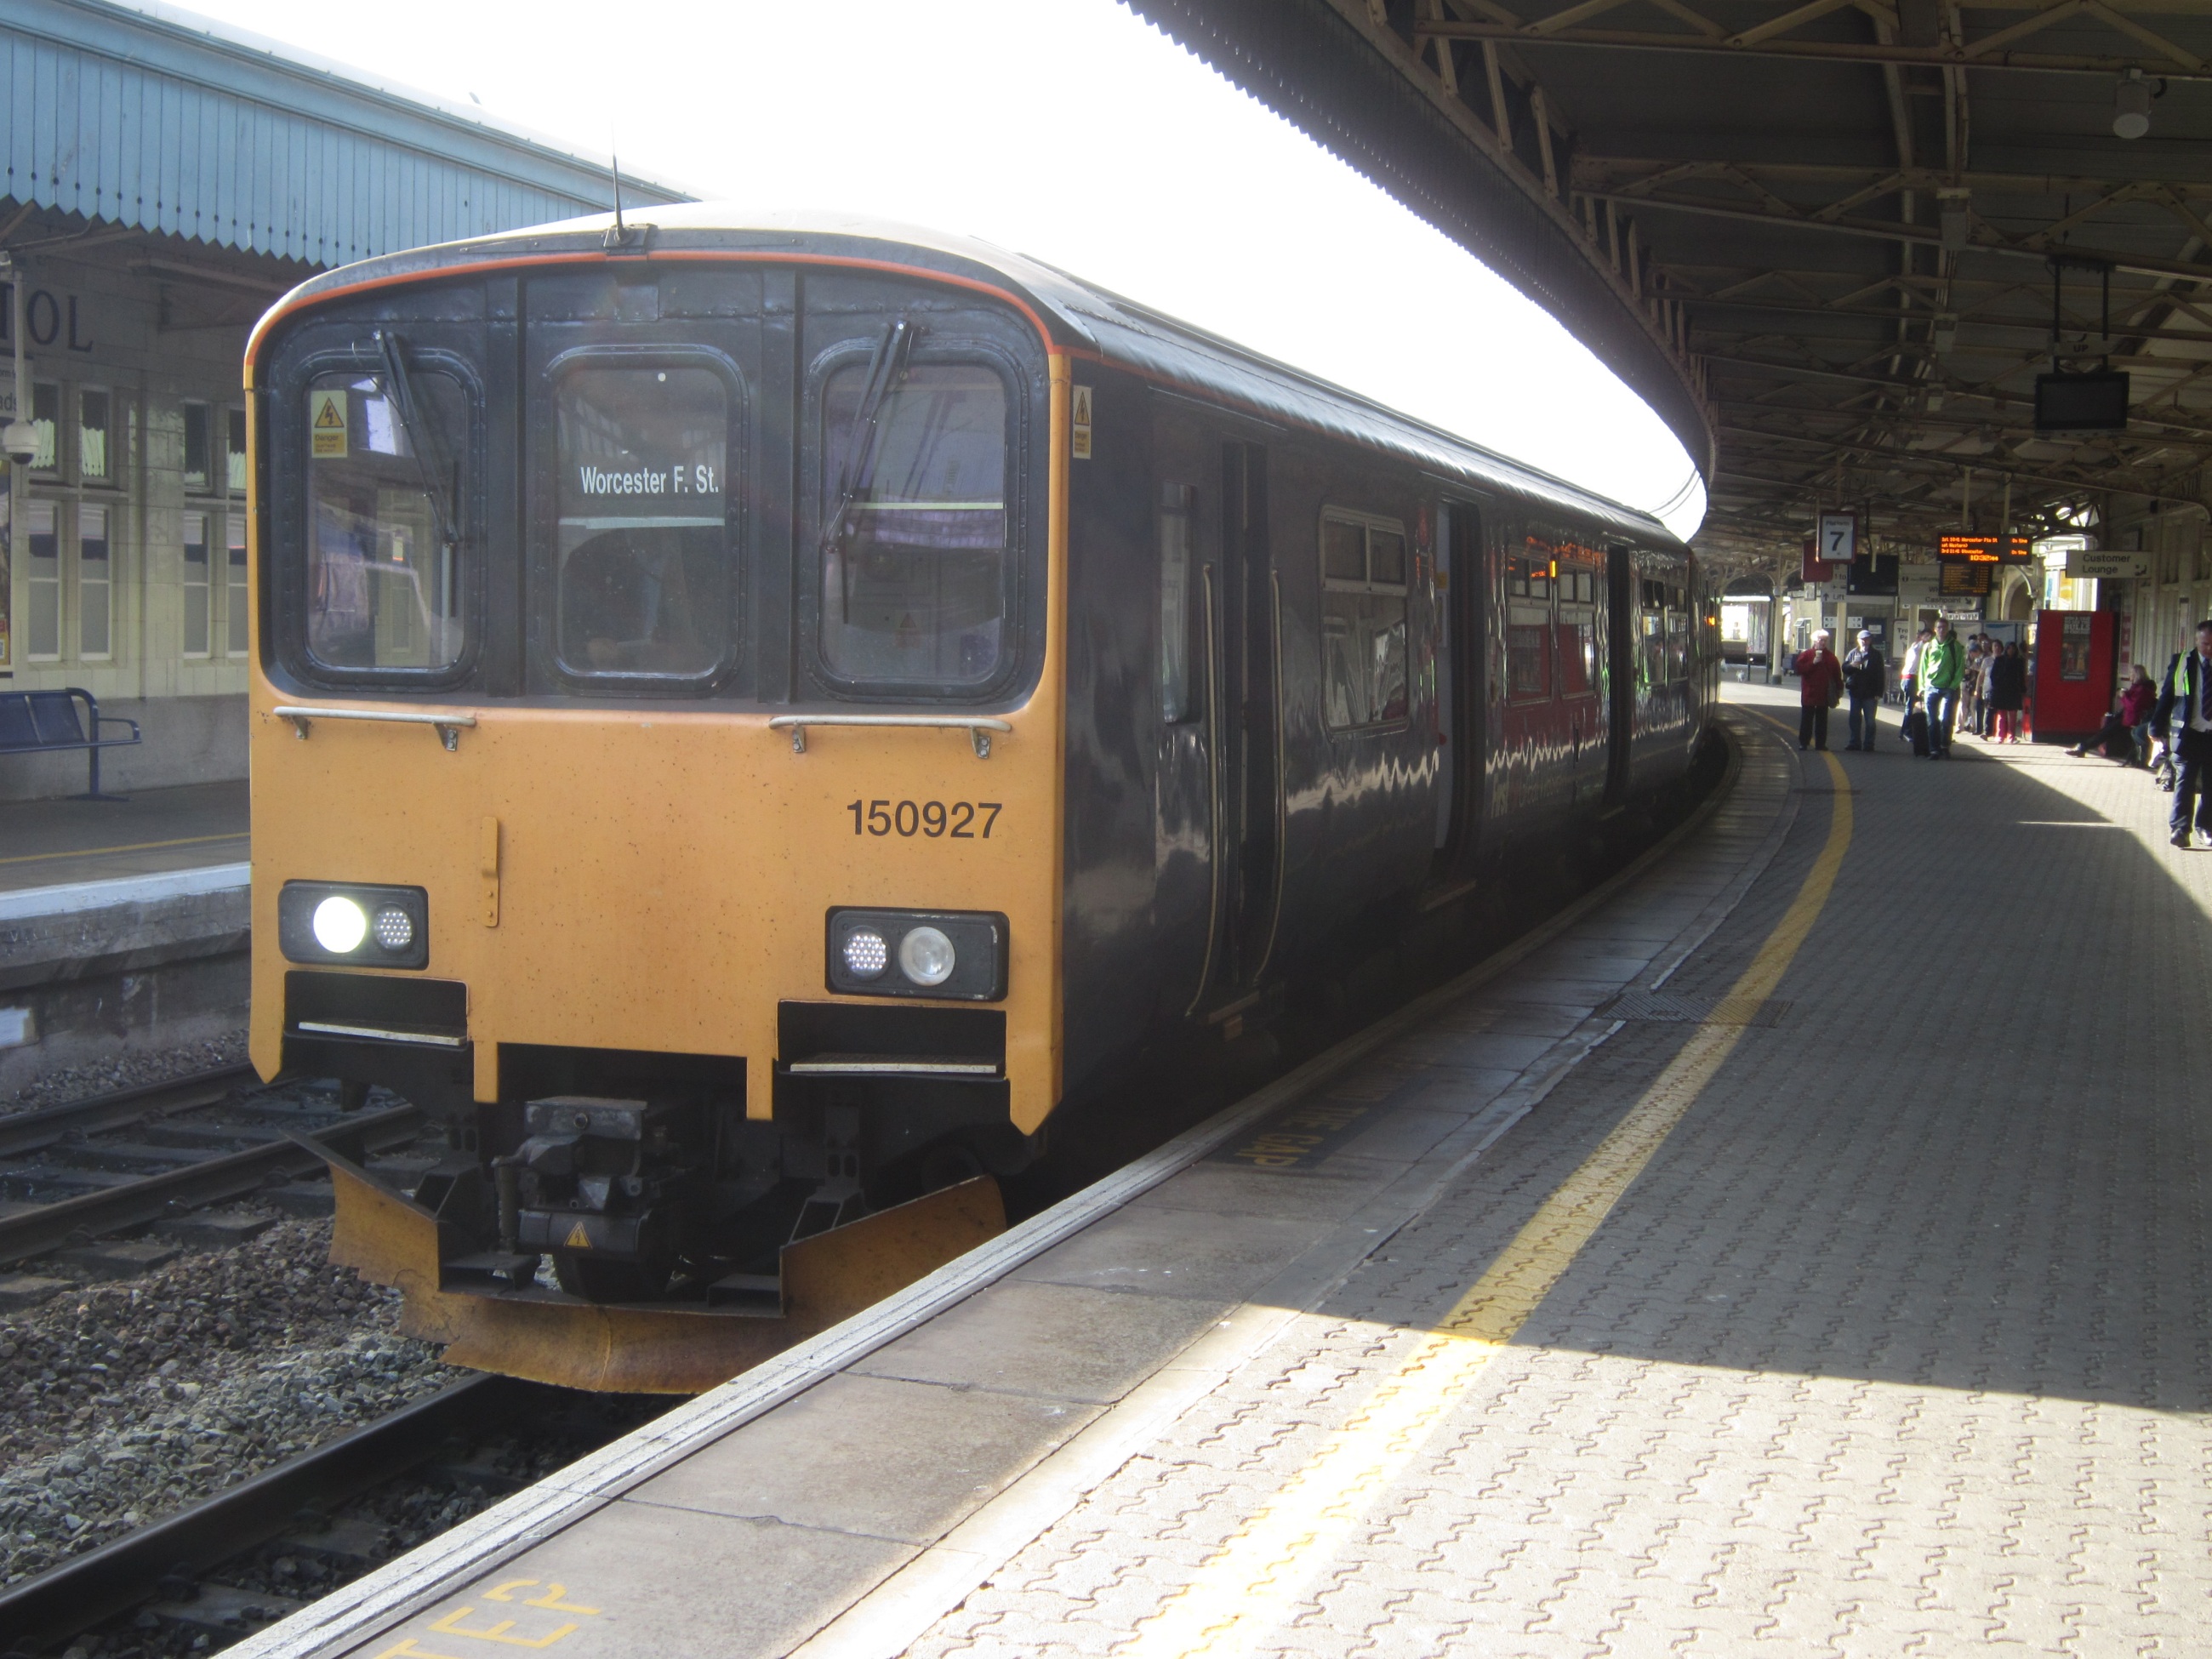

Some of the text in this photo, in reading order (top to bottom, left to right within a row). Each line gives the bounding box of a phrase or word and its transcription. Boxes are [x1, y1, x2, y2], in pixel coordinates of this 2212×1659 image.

[580, 465, 719, 493] Worcester F. St.
[1830, 531, 1844, 551] 7
[2083, 554, 2130, 562] Customer
[2083, 565, 2118, 575] Lounge
[847, 800, 1002, 838] 150927
